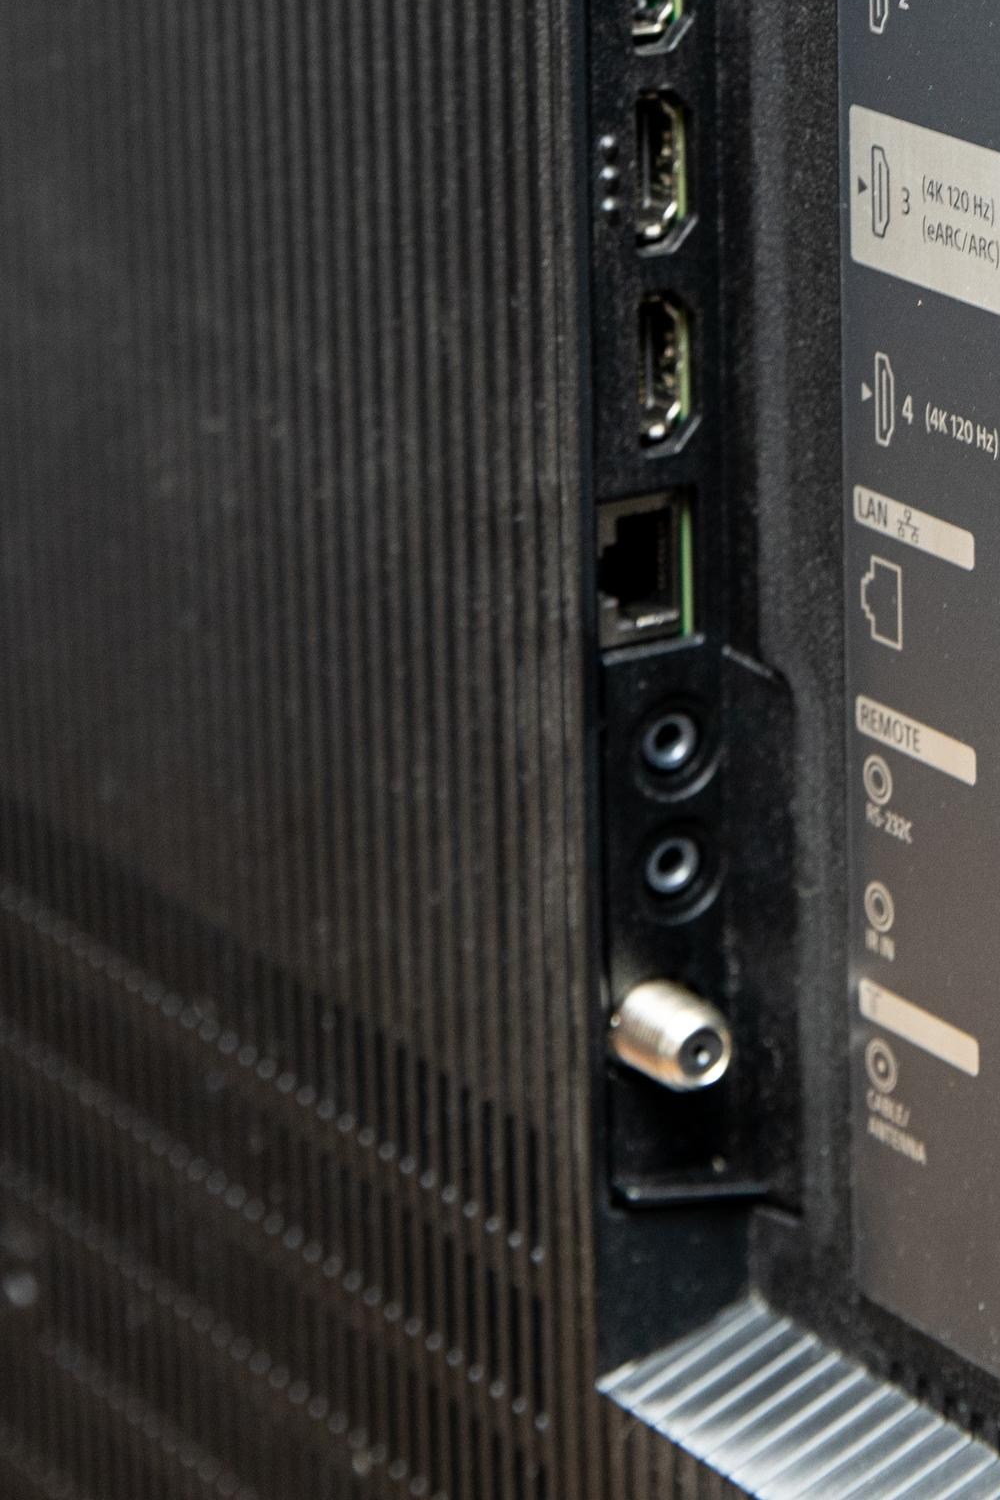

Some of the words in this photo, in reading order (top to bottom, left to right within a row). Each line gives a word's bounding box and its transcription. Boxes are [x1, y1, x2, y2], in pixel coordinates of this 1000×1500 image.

[902, 187, 910, 216] 3
[922, 174, 944, 205] (4K
[947, 190, 970, 213] 120
[973, 196, 995, 229] Hz)
[922, 215, 1000, 269] (eARC/ARC)
[902, 394, 914, 425] 4
[926, 402, 948, 435] (4K
[950, 414, 972, 445] 120
[976, 423, 998, 461] Hz)
[857, 493, 888, 527] LAN
[860, 703, 921, 754] REMOTE
